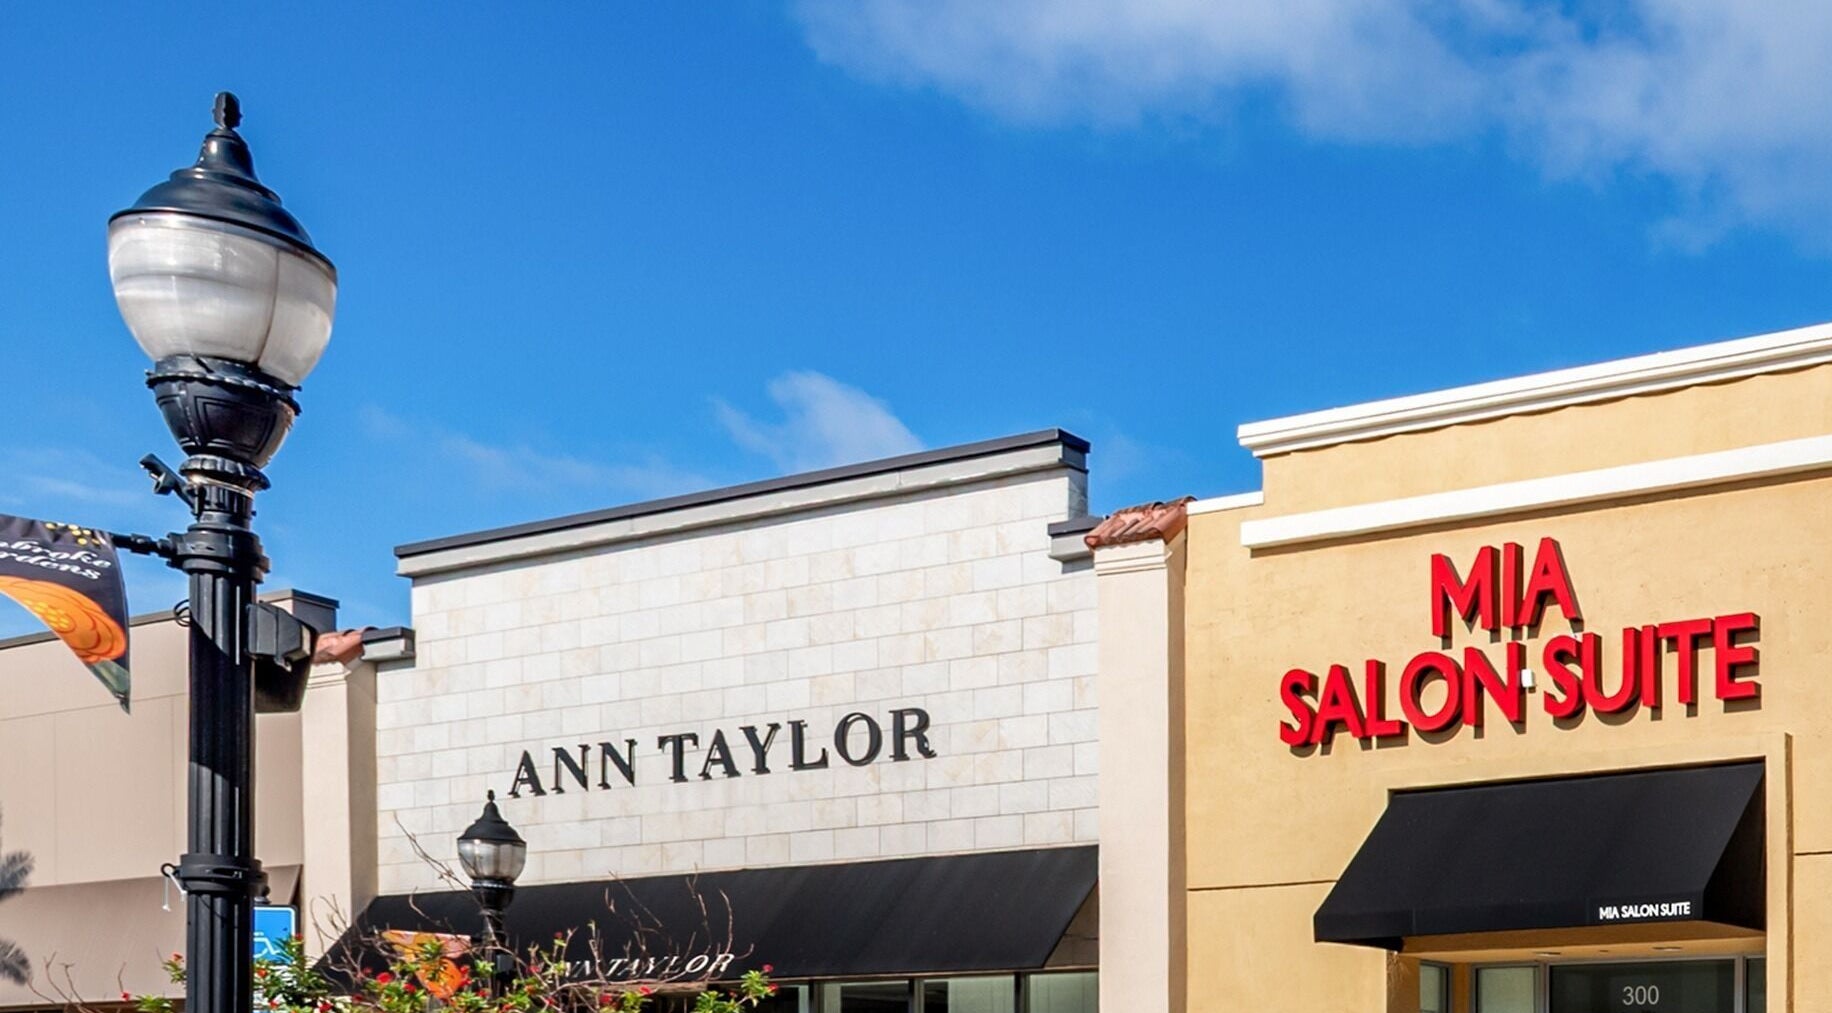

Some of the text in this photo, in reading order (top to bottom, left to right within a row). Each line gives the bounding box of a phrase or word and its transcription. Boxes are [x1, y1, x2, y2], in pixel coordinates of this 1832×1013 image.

[1431, 537, 1583, 637] MIA
[1280, 612, 1759, 746] SALON SUITE
[508, 707, 936, 798] ANN TAYLOR
[1599, 901, 1691, 919] MIA SALON SUITE
[1622, 985, 1660, 1005] 300
